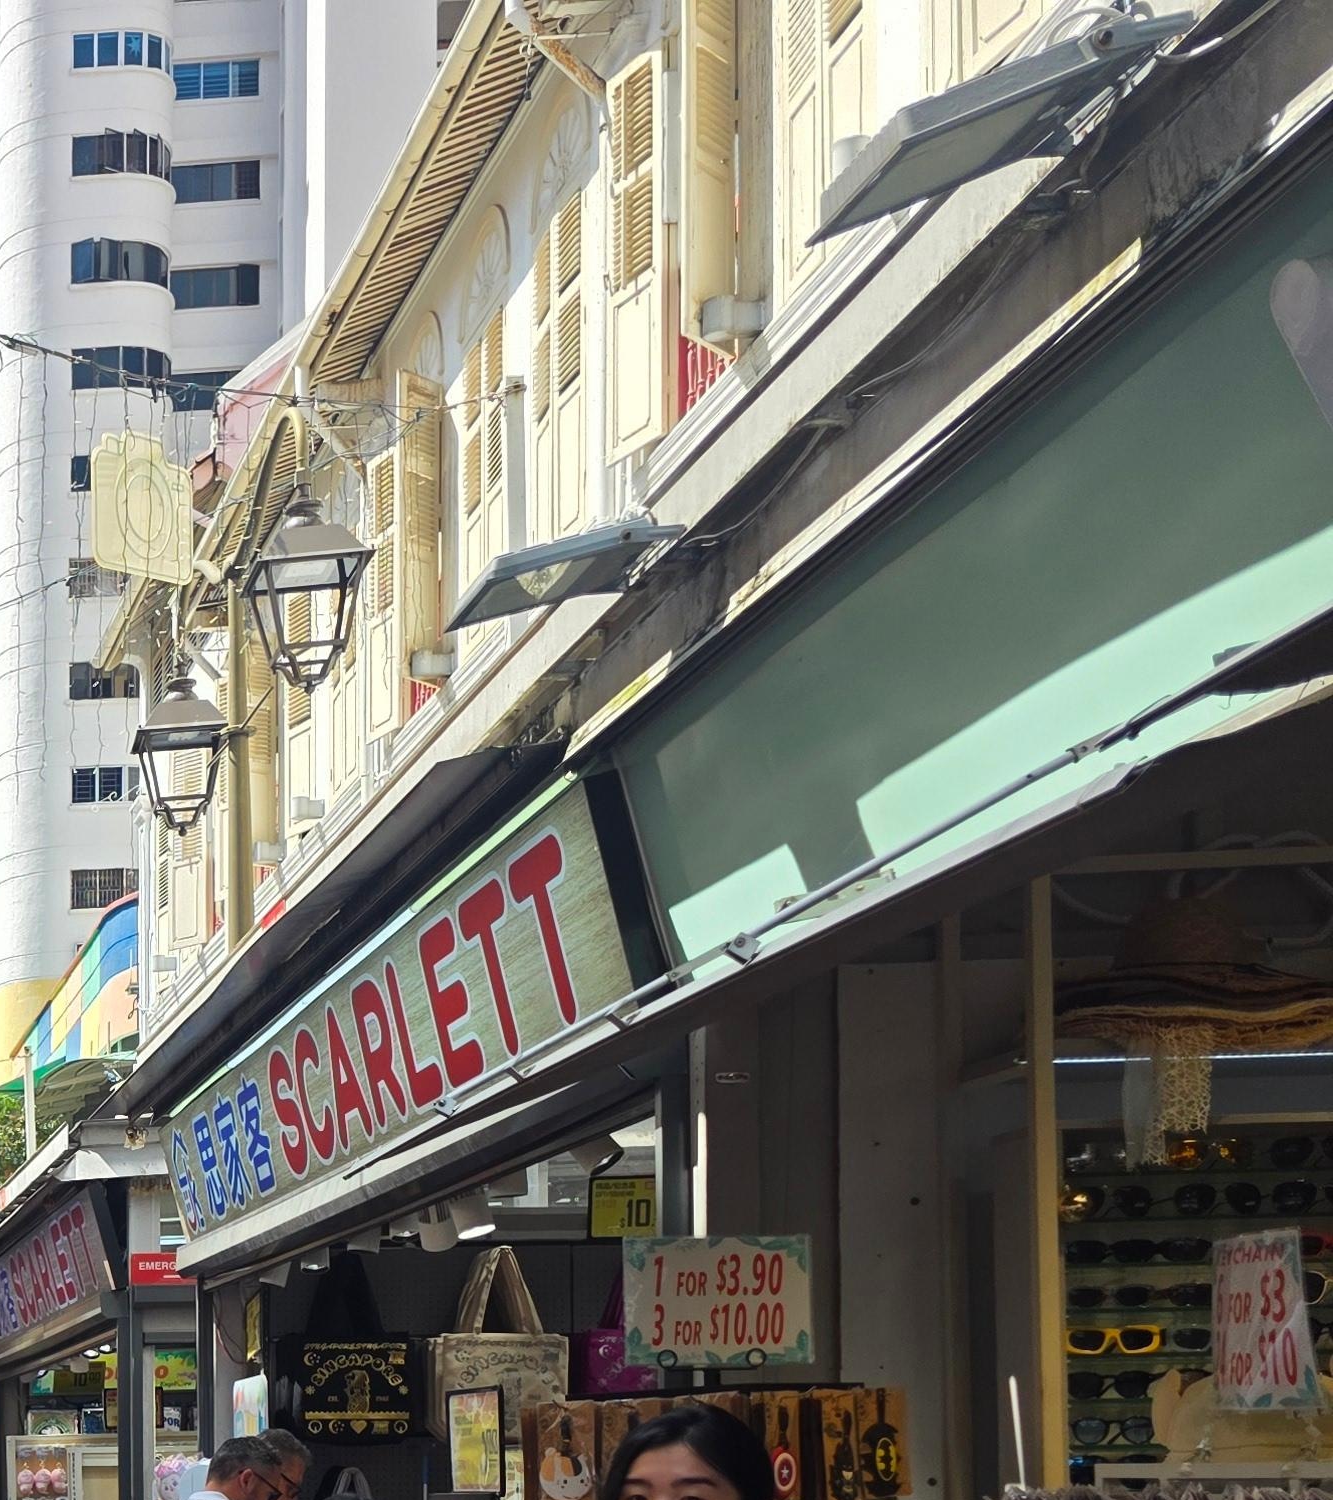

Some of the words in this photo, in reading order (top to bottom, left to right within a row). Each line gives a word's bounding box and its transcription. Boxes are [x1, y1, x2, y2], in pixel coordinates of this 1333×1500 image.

[268, 829, 578, 1178] SCARLETT
[191, 1073, 276, 1221] 思家客
[10, 1201, 99, 1327] SCARLETT
[654, 1255, 664, 1297] 1
[676, 1271, 708, 1297] FOR
[716, 1253, 783, 1296] $3.90
[1219, 1243, 1284, 1268] EYCHAIN
[651, 1304, 665, 1346] 3
[674, 1321, 703, 1345] FOR
[709, 1302, 784, 1346] $10.00
[1260, 1268, 1286, 1324] $3
[311, 1352, 403, 1387] SINGAPORE
[1258, 1327, 1298, 1386] $10
